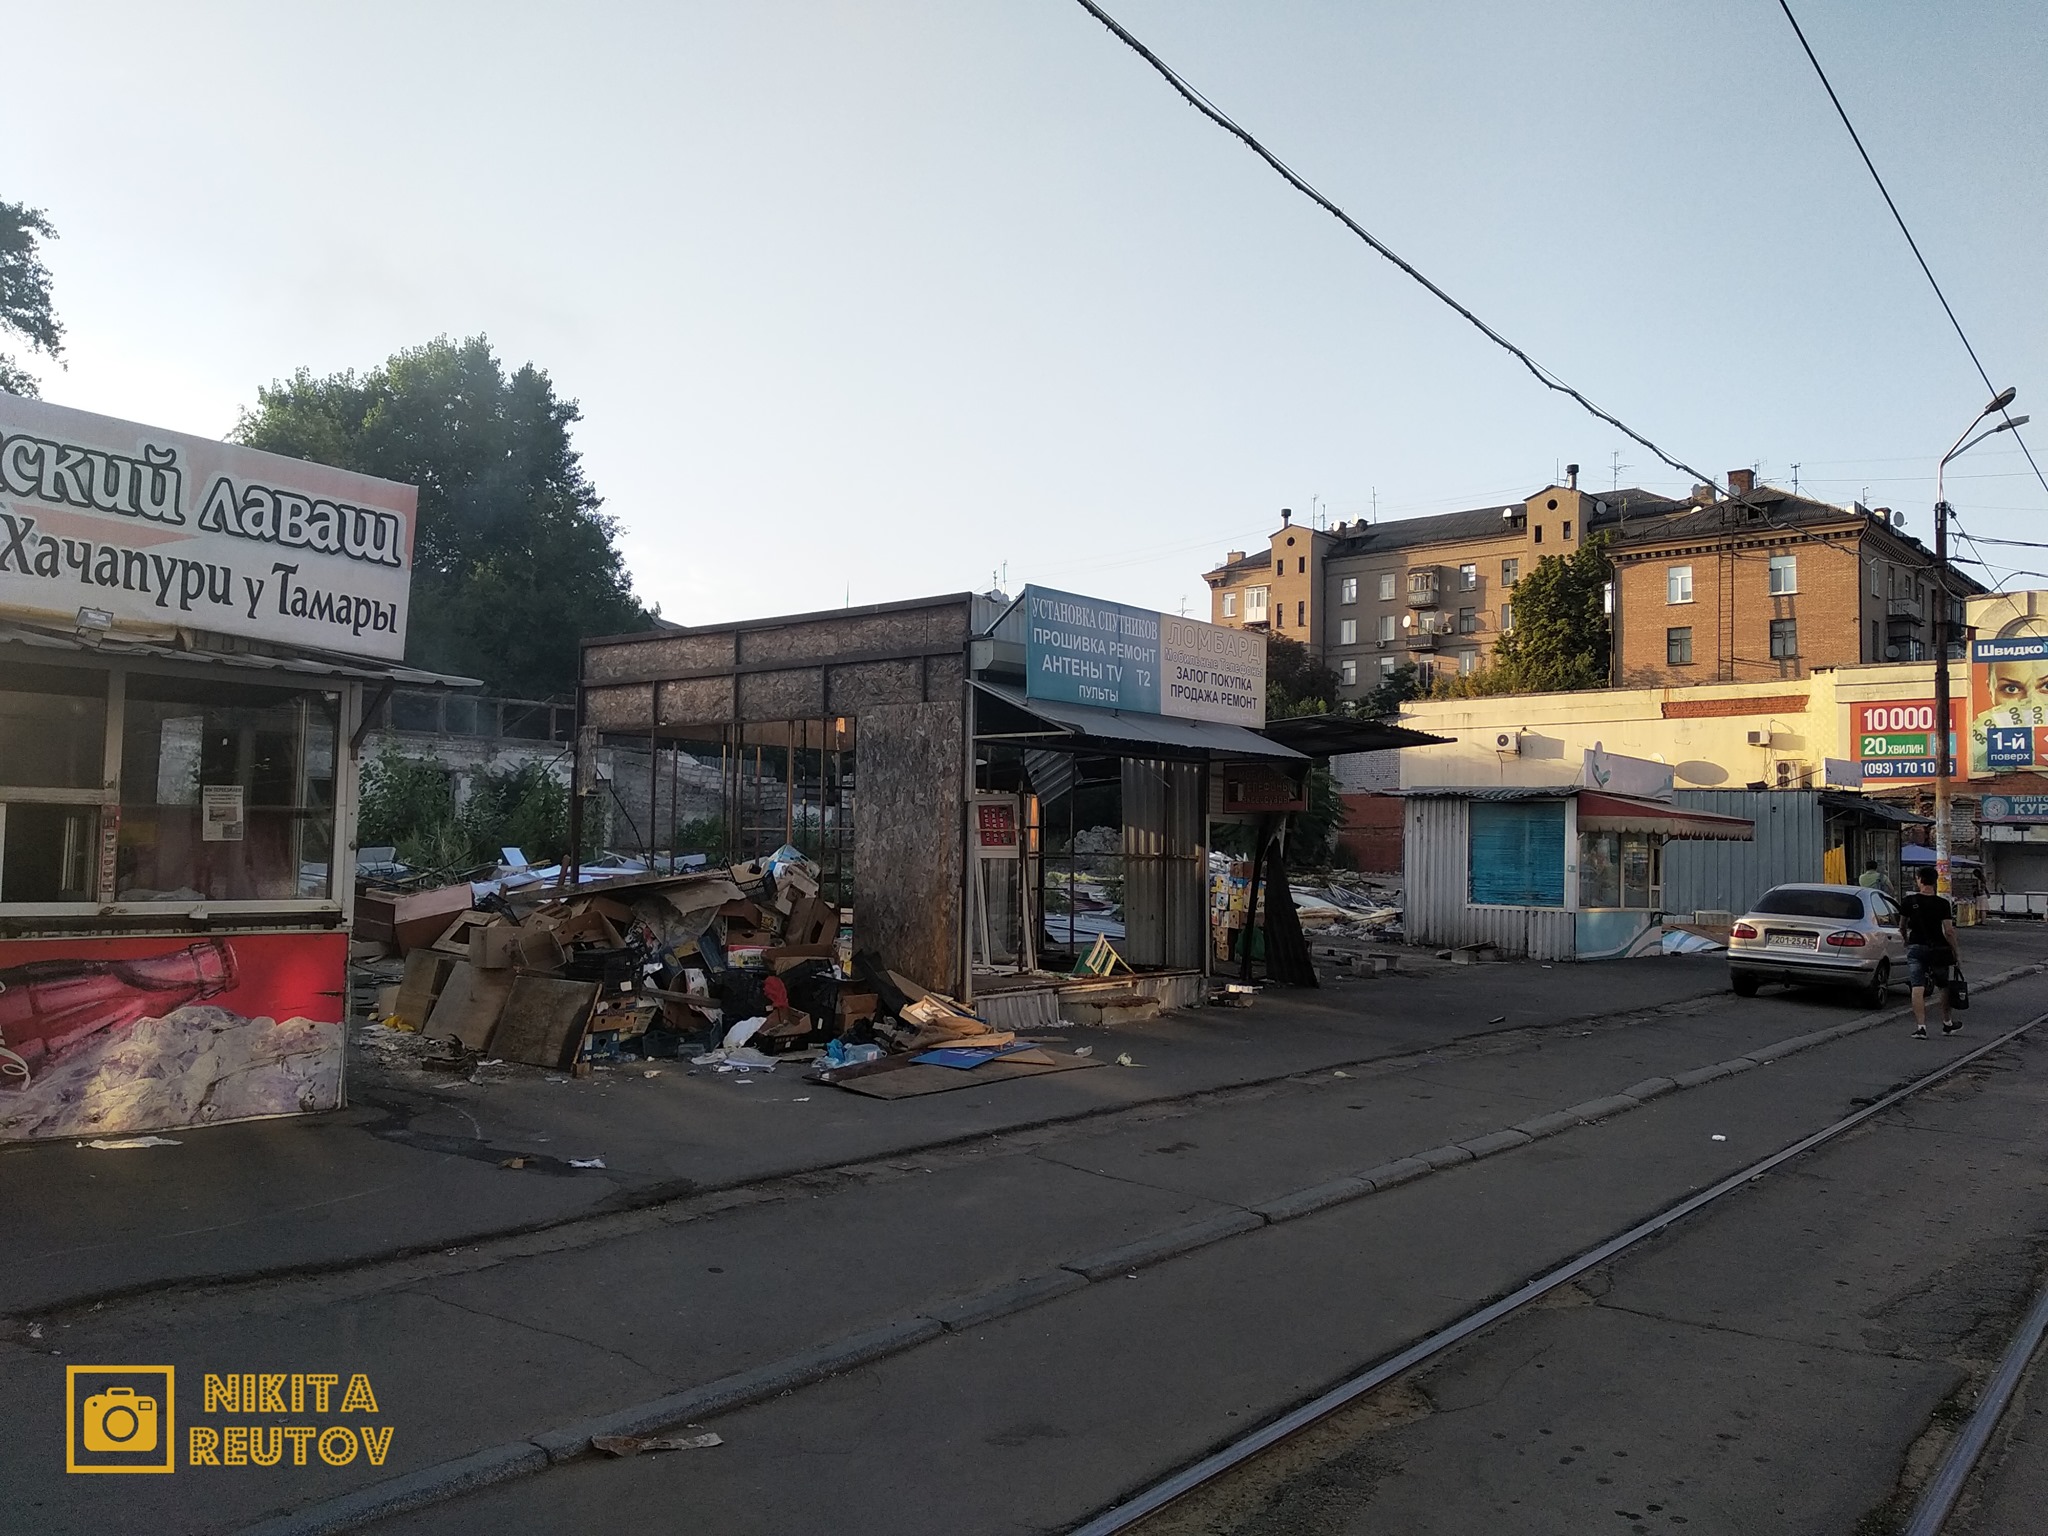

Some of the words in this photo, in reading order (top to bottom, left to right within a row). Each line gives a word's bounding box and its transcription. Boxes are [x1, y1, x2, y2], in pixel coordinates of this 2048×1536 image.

[0, 432, 186, 526] ский
[0, 513, 234, 612] Хачапури
[242, 576, 266, 620] у
[271, 562, 398, 637] Тамары
[1032, 597, 1096, 629] УСТАНОВКА
[1098, 610, 1158, 640] СПУТНИКОВ
[1033, 627, 1106, 655] ПРОШИВКА
[1109, 641, 1156, 663] РЕМОНТ
[1168, 621, 1260, 665] ЛОМБАРД
[1042, 653, 1103, 680] АНТЕНЫ
[1106, 664, 1123, 683] TV
[1165, 647, 1218, 670] Мобильные
[1220, 657, 1263, 678] Телефоны
[1176, 666, 1208, 684] ЗАЛОГ
[1211, 672, 1252, 691] ПОКУПКА
[1079, 684, 1119, 702] ПУЛЬТЫ
[1170, 683, 1219, 704] ПРОДАЖА
[1221, 692, 1257, 710] РЕМОНТ
[1864, 737, 1886, 755] 20
[1992, 731, 2025, 750] 1-й
[1864, 762, 1893, 777] (093)
[1896, 762, 1917, 774] 170
[1990, 752, 2030, 762] поверх
